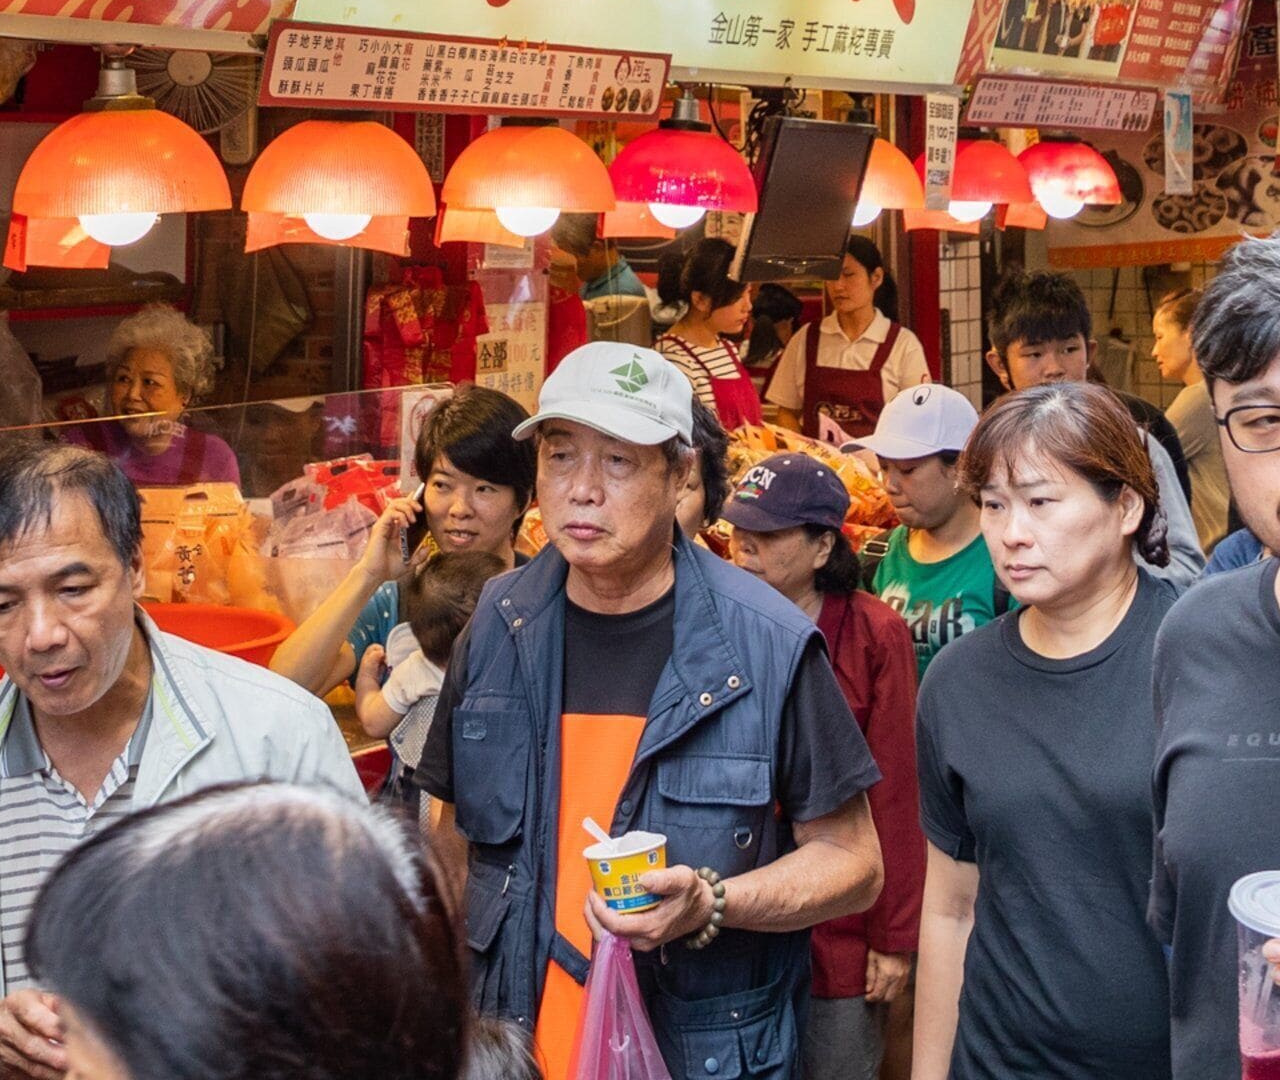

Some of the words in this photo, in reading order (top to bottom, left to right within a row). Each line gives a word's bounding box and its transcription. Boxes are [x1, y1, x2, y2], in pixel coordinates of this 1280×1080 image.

[708, 11, 796, 50] 金山第一家
[479, 341, 508, 370] 全部
